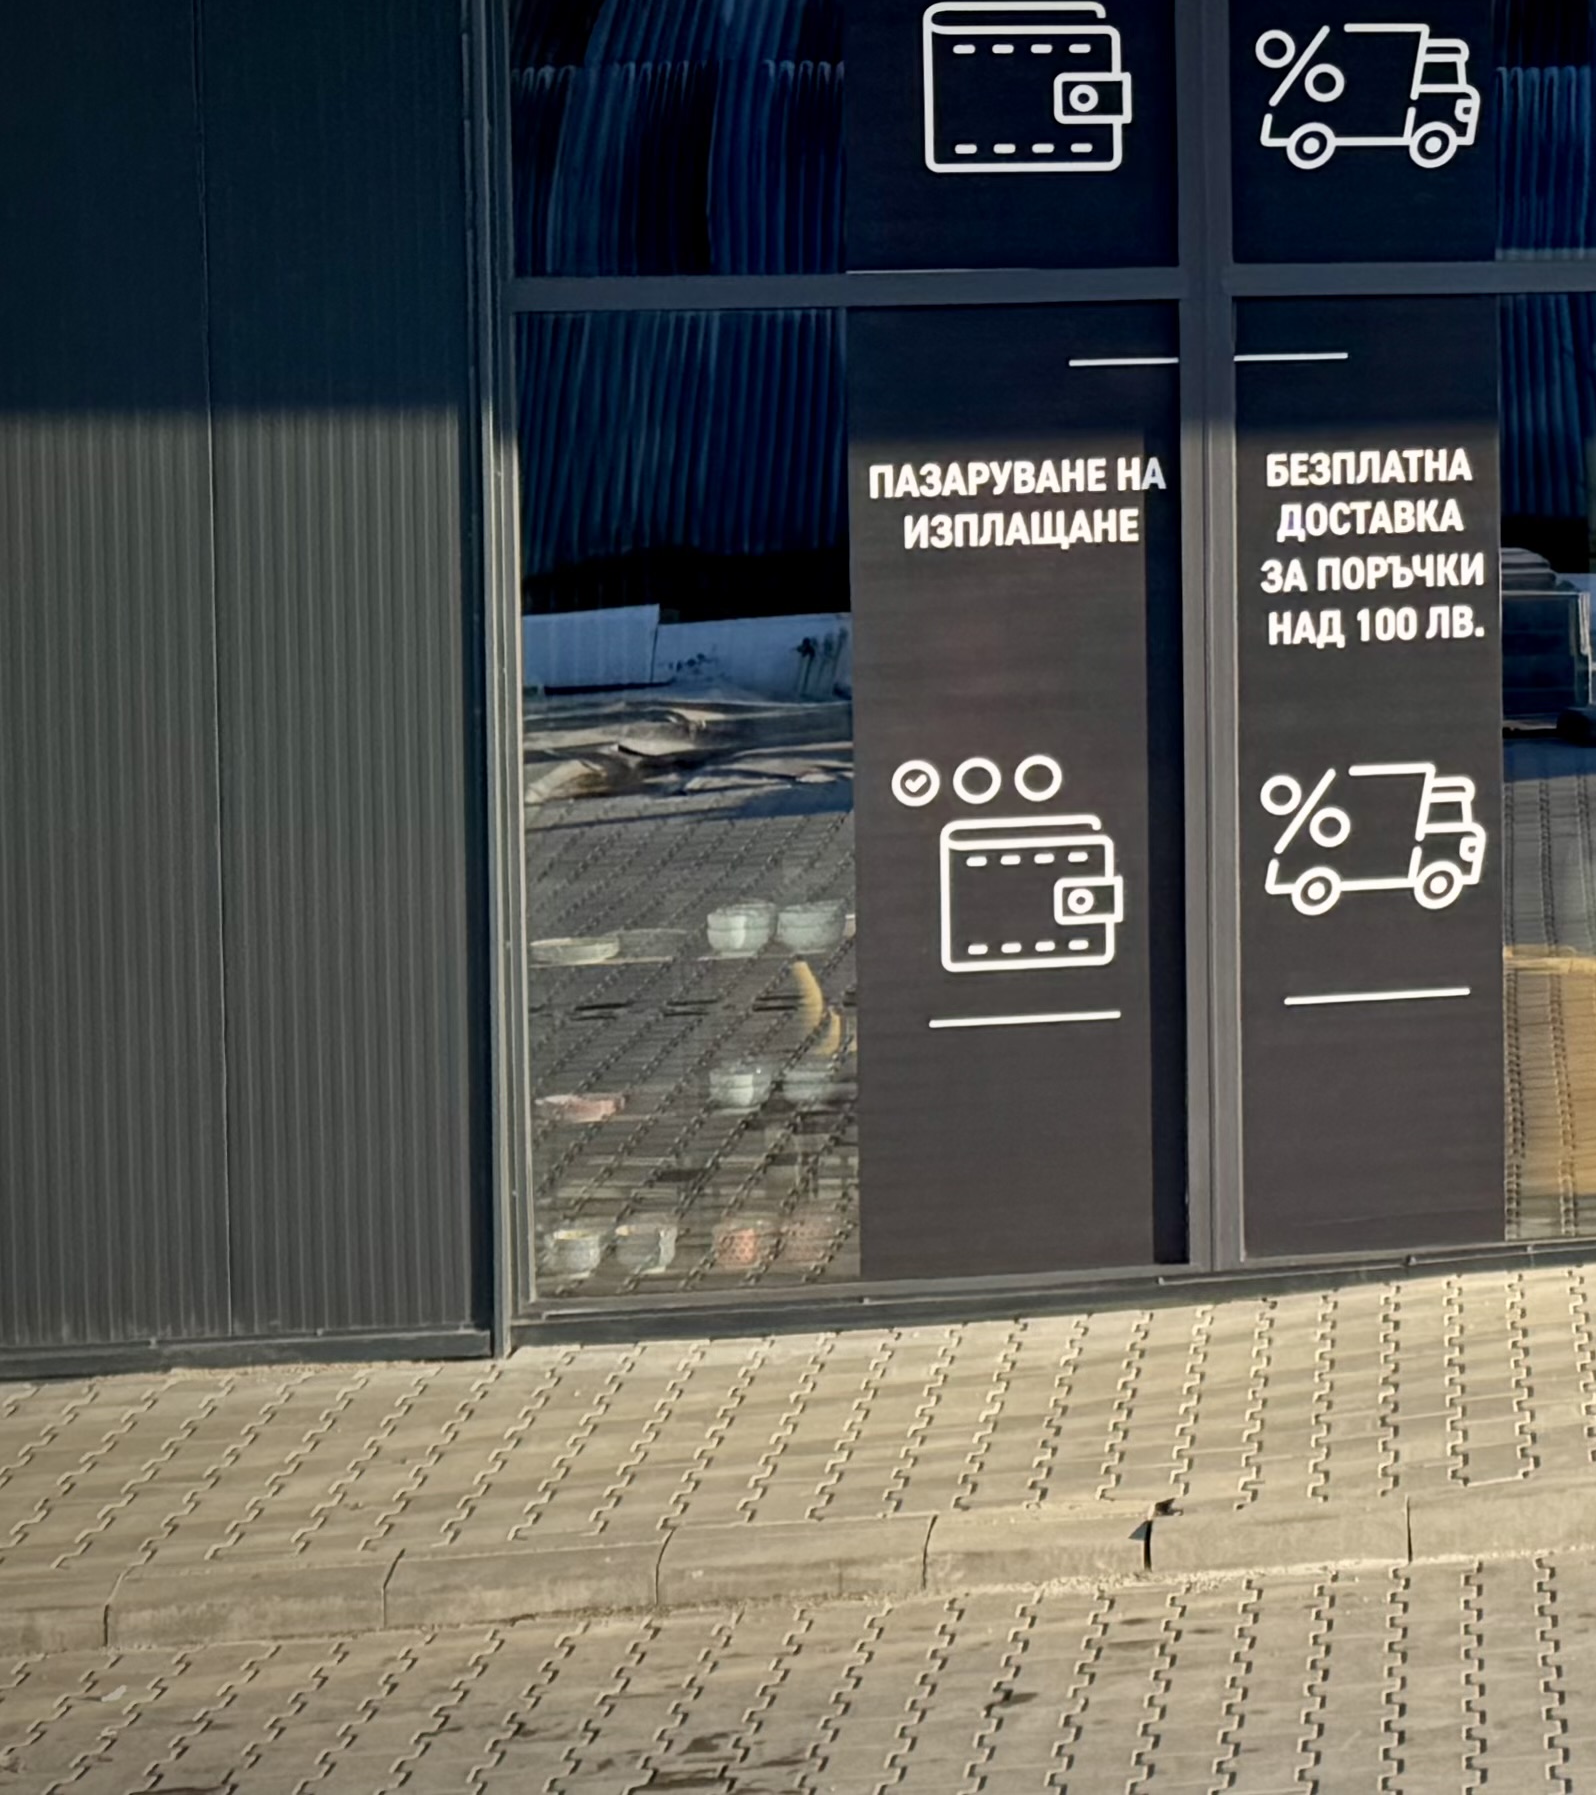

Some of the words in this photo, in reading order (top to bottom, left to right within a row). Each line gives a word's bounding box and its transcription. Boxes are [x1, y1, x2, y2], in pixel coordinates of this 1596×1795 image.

[870, 458, 1106, 499] ПАЗАРУВАНЕ
[1117, 457, 1165, 491] НА
[1267, 448, 1472, 487] БЕЗПЛАТНА
[904, 508, 1139, 549] ИЗПЛАЩАНЕ
[1277, 499, 1464, 542] ДОСТАВКА
[1261, 559, 1308, 593] ЗА
[1318, 552, 1484, 591] ПОРЪЧКИ
[1269, 609, 1345, 649] НАД
[1357, 607, 1417, 641] 100
[1426, 605, 1484, 639] ЛВ.
